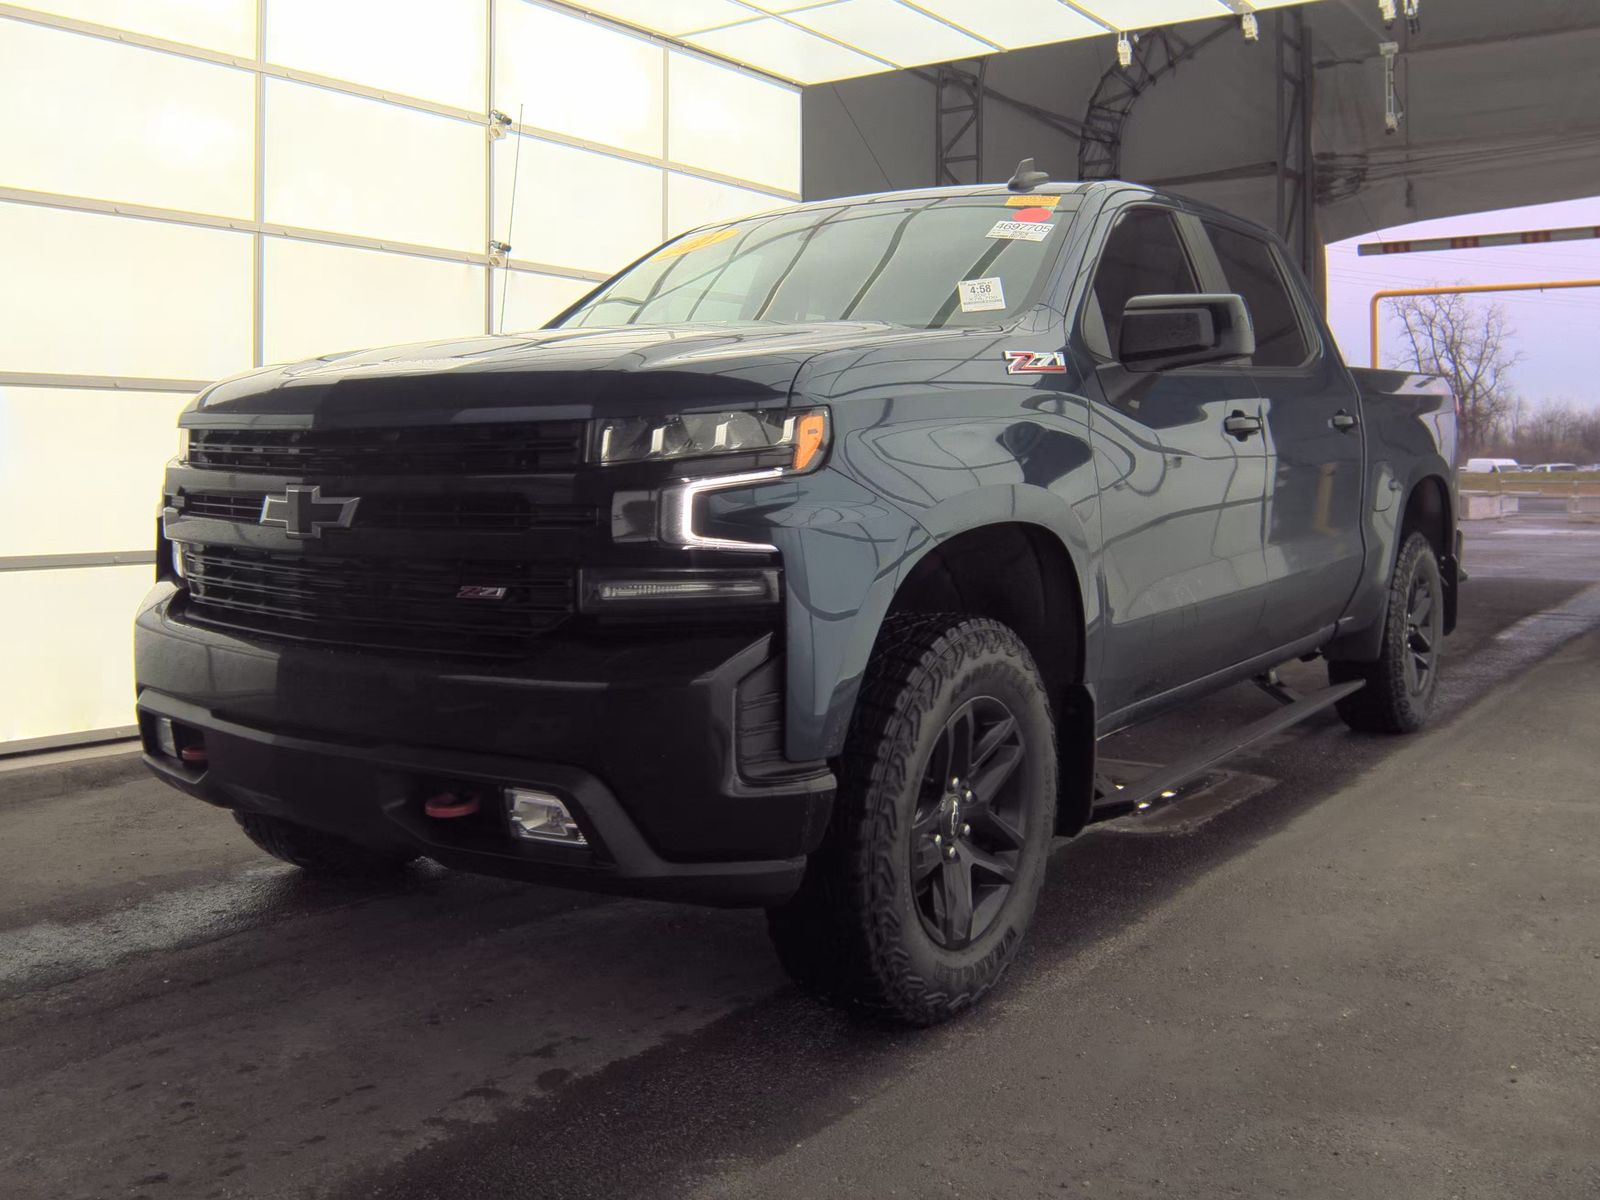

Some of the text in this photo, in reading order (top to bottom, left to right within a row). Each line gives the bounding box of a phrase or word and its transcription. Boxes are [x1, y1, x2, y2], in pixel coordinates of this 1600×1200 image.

[996, 222, 1050, 233] 4697705
[970, 284, 991, 294] 4:58
[1003, 351, 1067, 375] Z71
[456, 586, 507, 600] Z71
